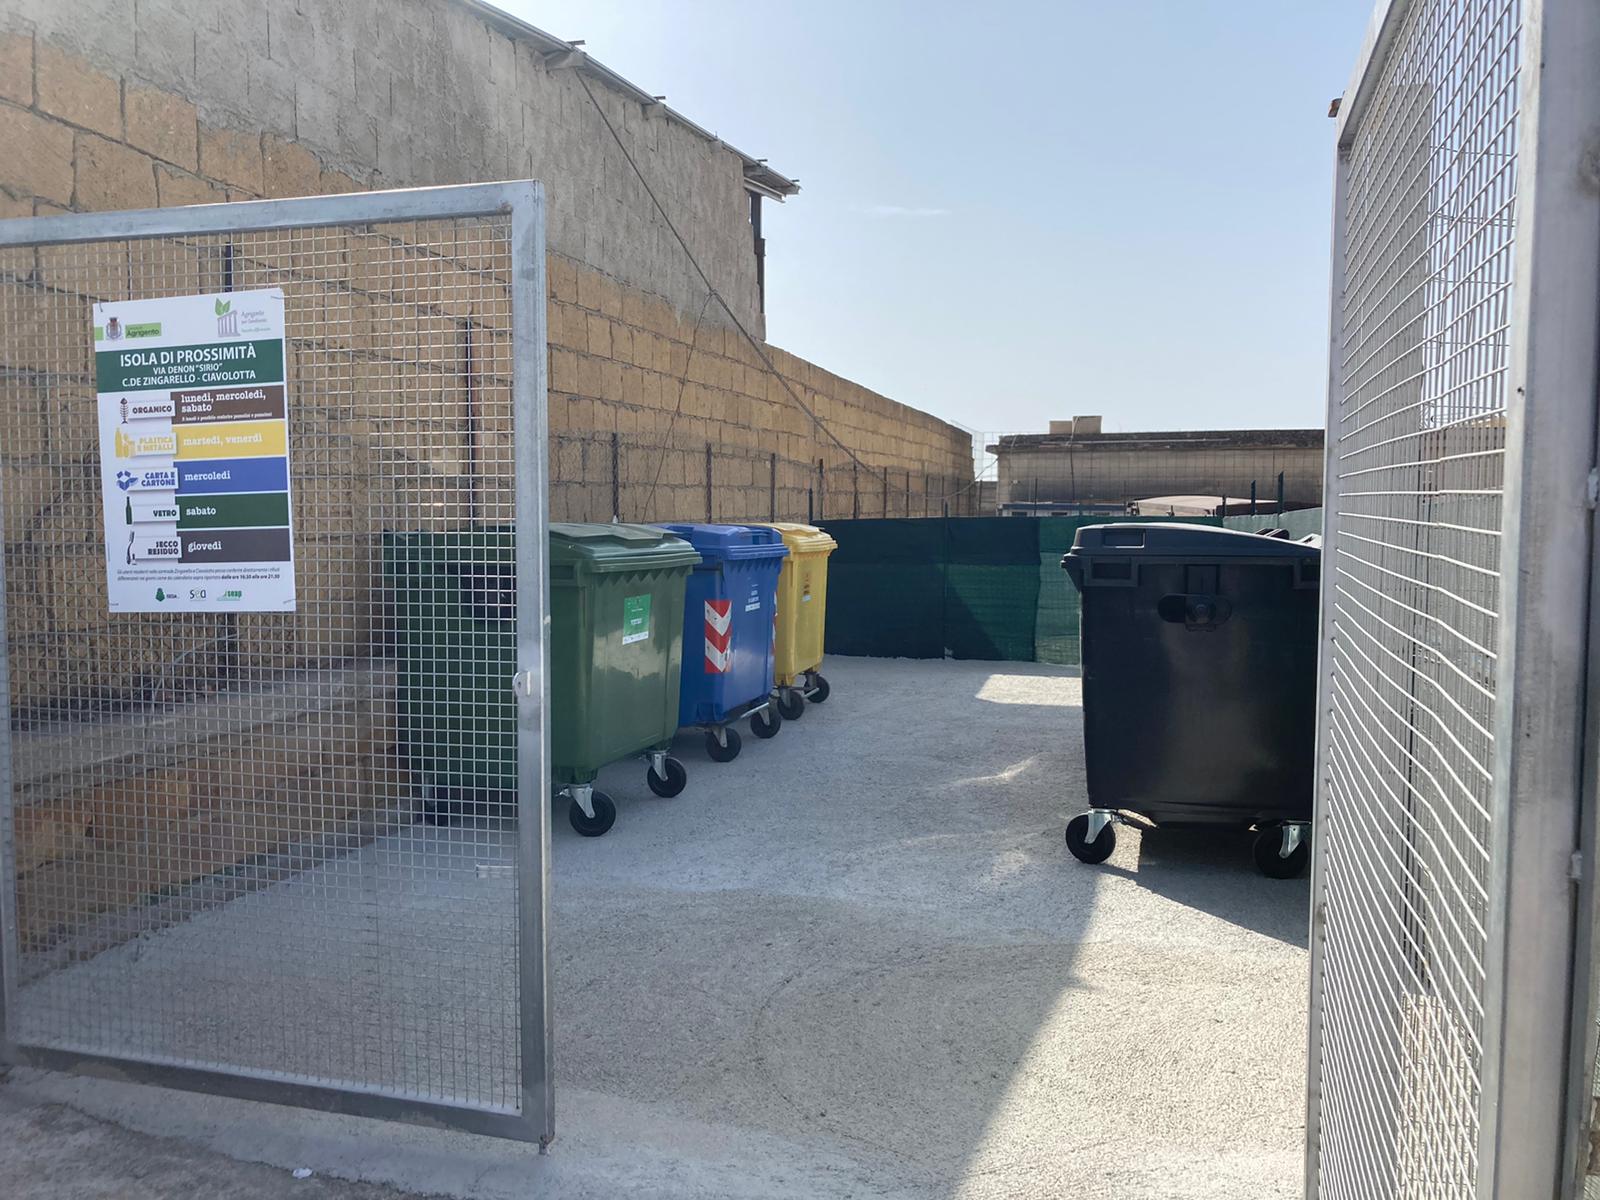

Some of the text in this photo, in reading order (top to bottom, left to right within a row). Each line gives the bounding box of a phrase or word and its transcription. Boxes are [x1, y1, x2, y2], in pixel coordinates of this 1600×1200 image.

[126, 328, 160, 337] Agrigento
[120, 343, 256, 367] ISOLA DI PROSSIMITÀ
[153, 366, 166, 375] VIA
[168, 365, 194, 374] DENON
[122, 377, 141, 387] C.DE
[143, 374, 196, 386] ZINGARELLO
[202, 370, 256, 382] CIAVOLOTTA
[132, 406, 172, 414] ORGANICO
[182, 403, 212, 413] sabato
[186, 507, 216, 516] sabato
